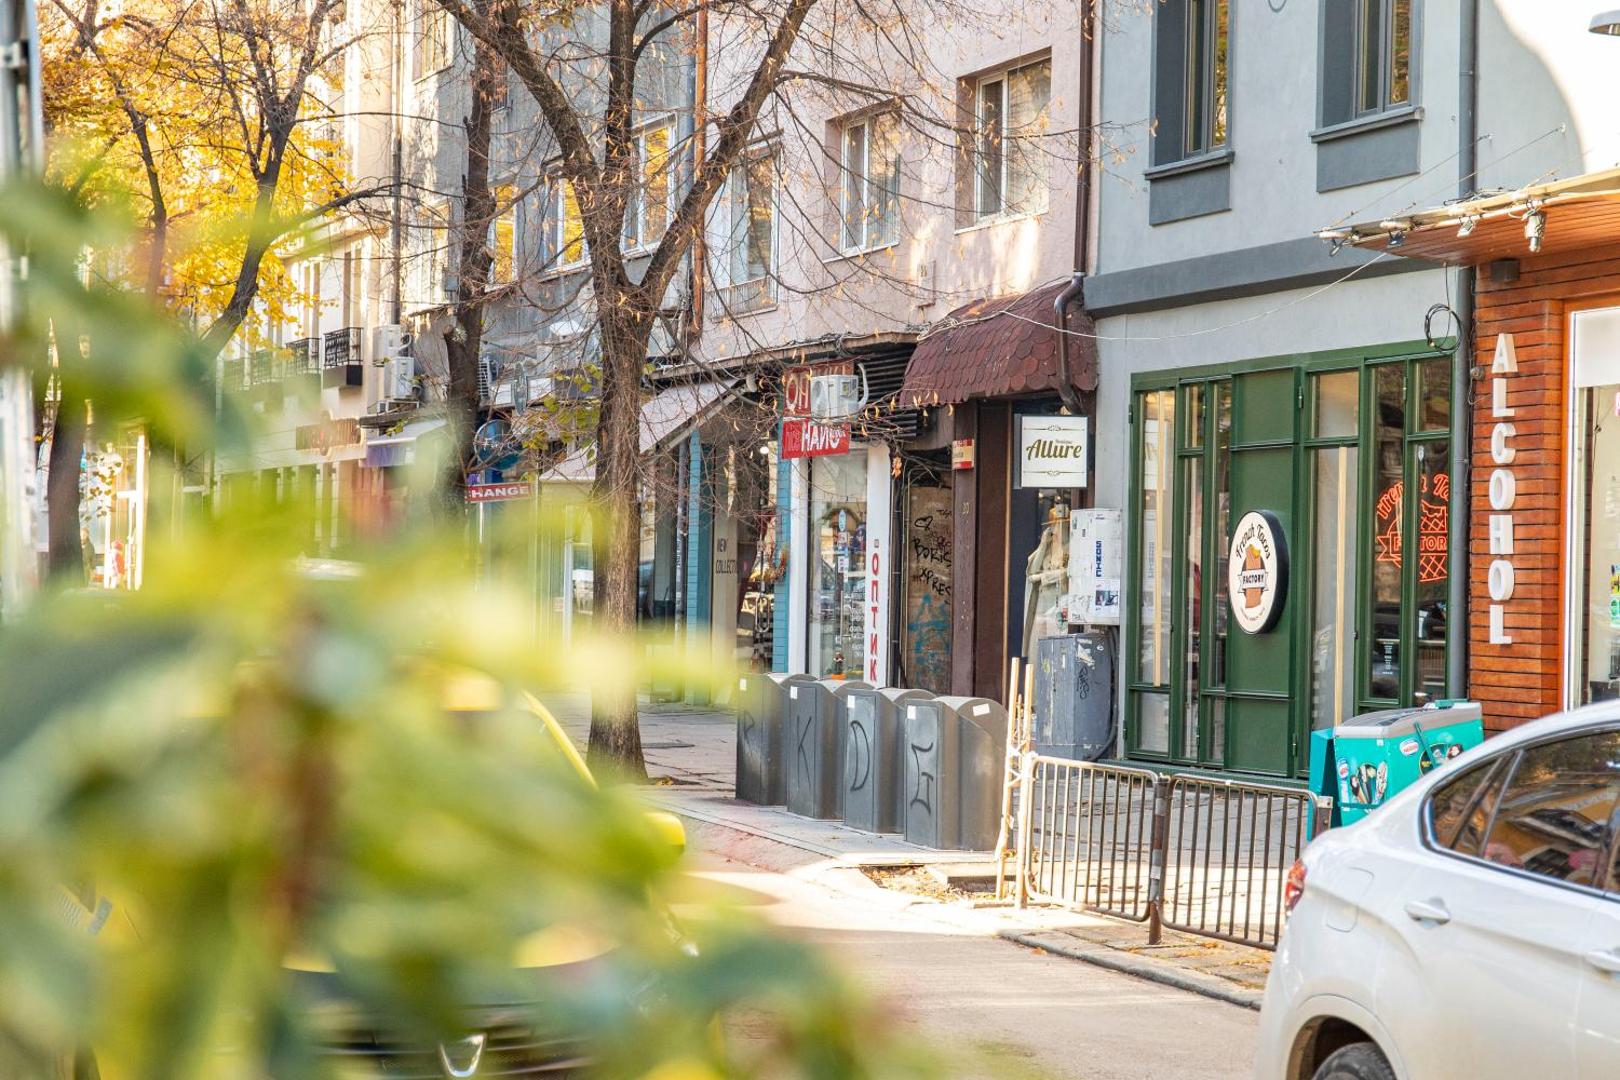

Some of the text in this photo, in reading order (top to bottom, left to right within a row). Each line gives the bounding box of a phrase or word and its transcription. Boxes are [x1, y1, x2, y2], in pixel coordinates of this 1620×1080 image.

[1026, 439, 1082, 461] Allure
[469, 486, 529, 499] HANGE
[1488, 332, 1519, 645] ALCOHOL
[1242, 574, 1264, 585] FACTORY
